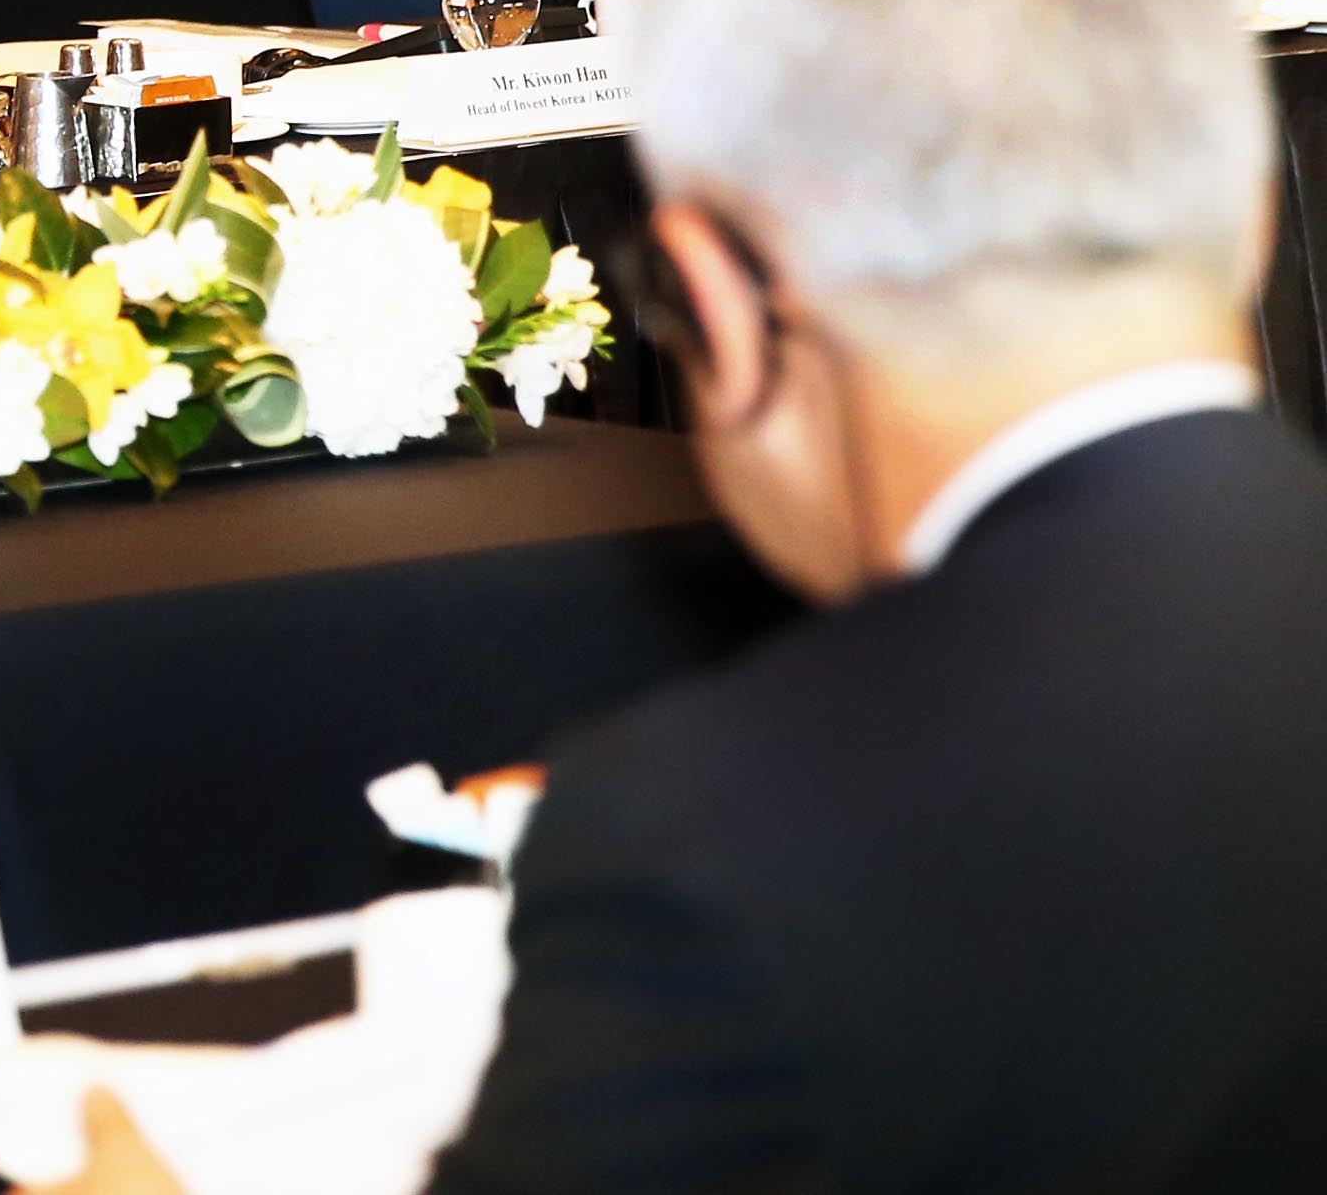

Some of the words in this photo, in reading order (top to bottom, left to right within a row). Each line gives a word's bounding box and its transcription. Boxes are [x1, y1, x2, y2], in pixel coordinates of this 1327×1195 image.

[492, 76, 519, 92] Mr.
[523, 71, 573, 89] Kiwon
[576, 66, 608, 83] Han
[467, 102, 497, 116] Head
[500, 100, 512, 113] of
[515, 98, 549, 112] Invest
[550, 94, 586, 107] Korea
[595, 86, 634, 102] KOTR
